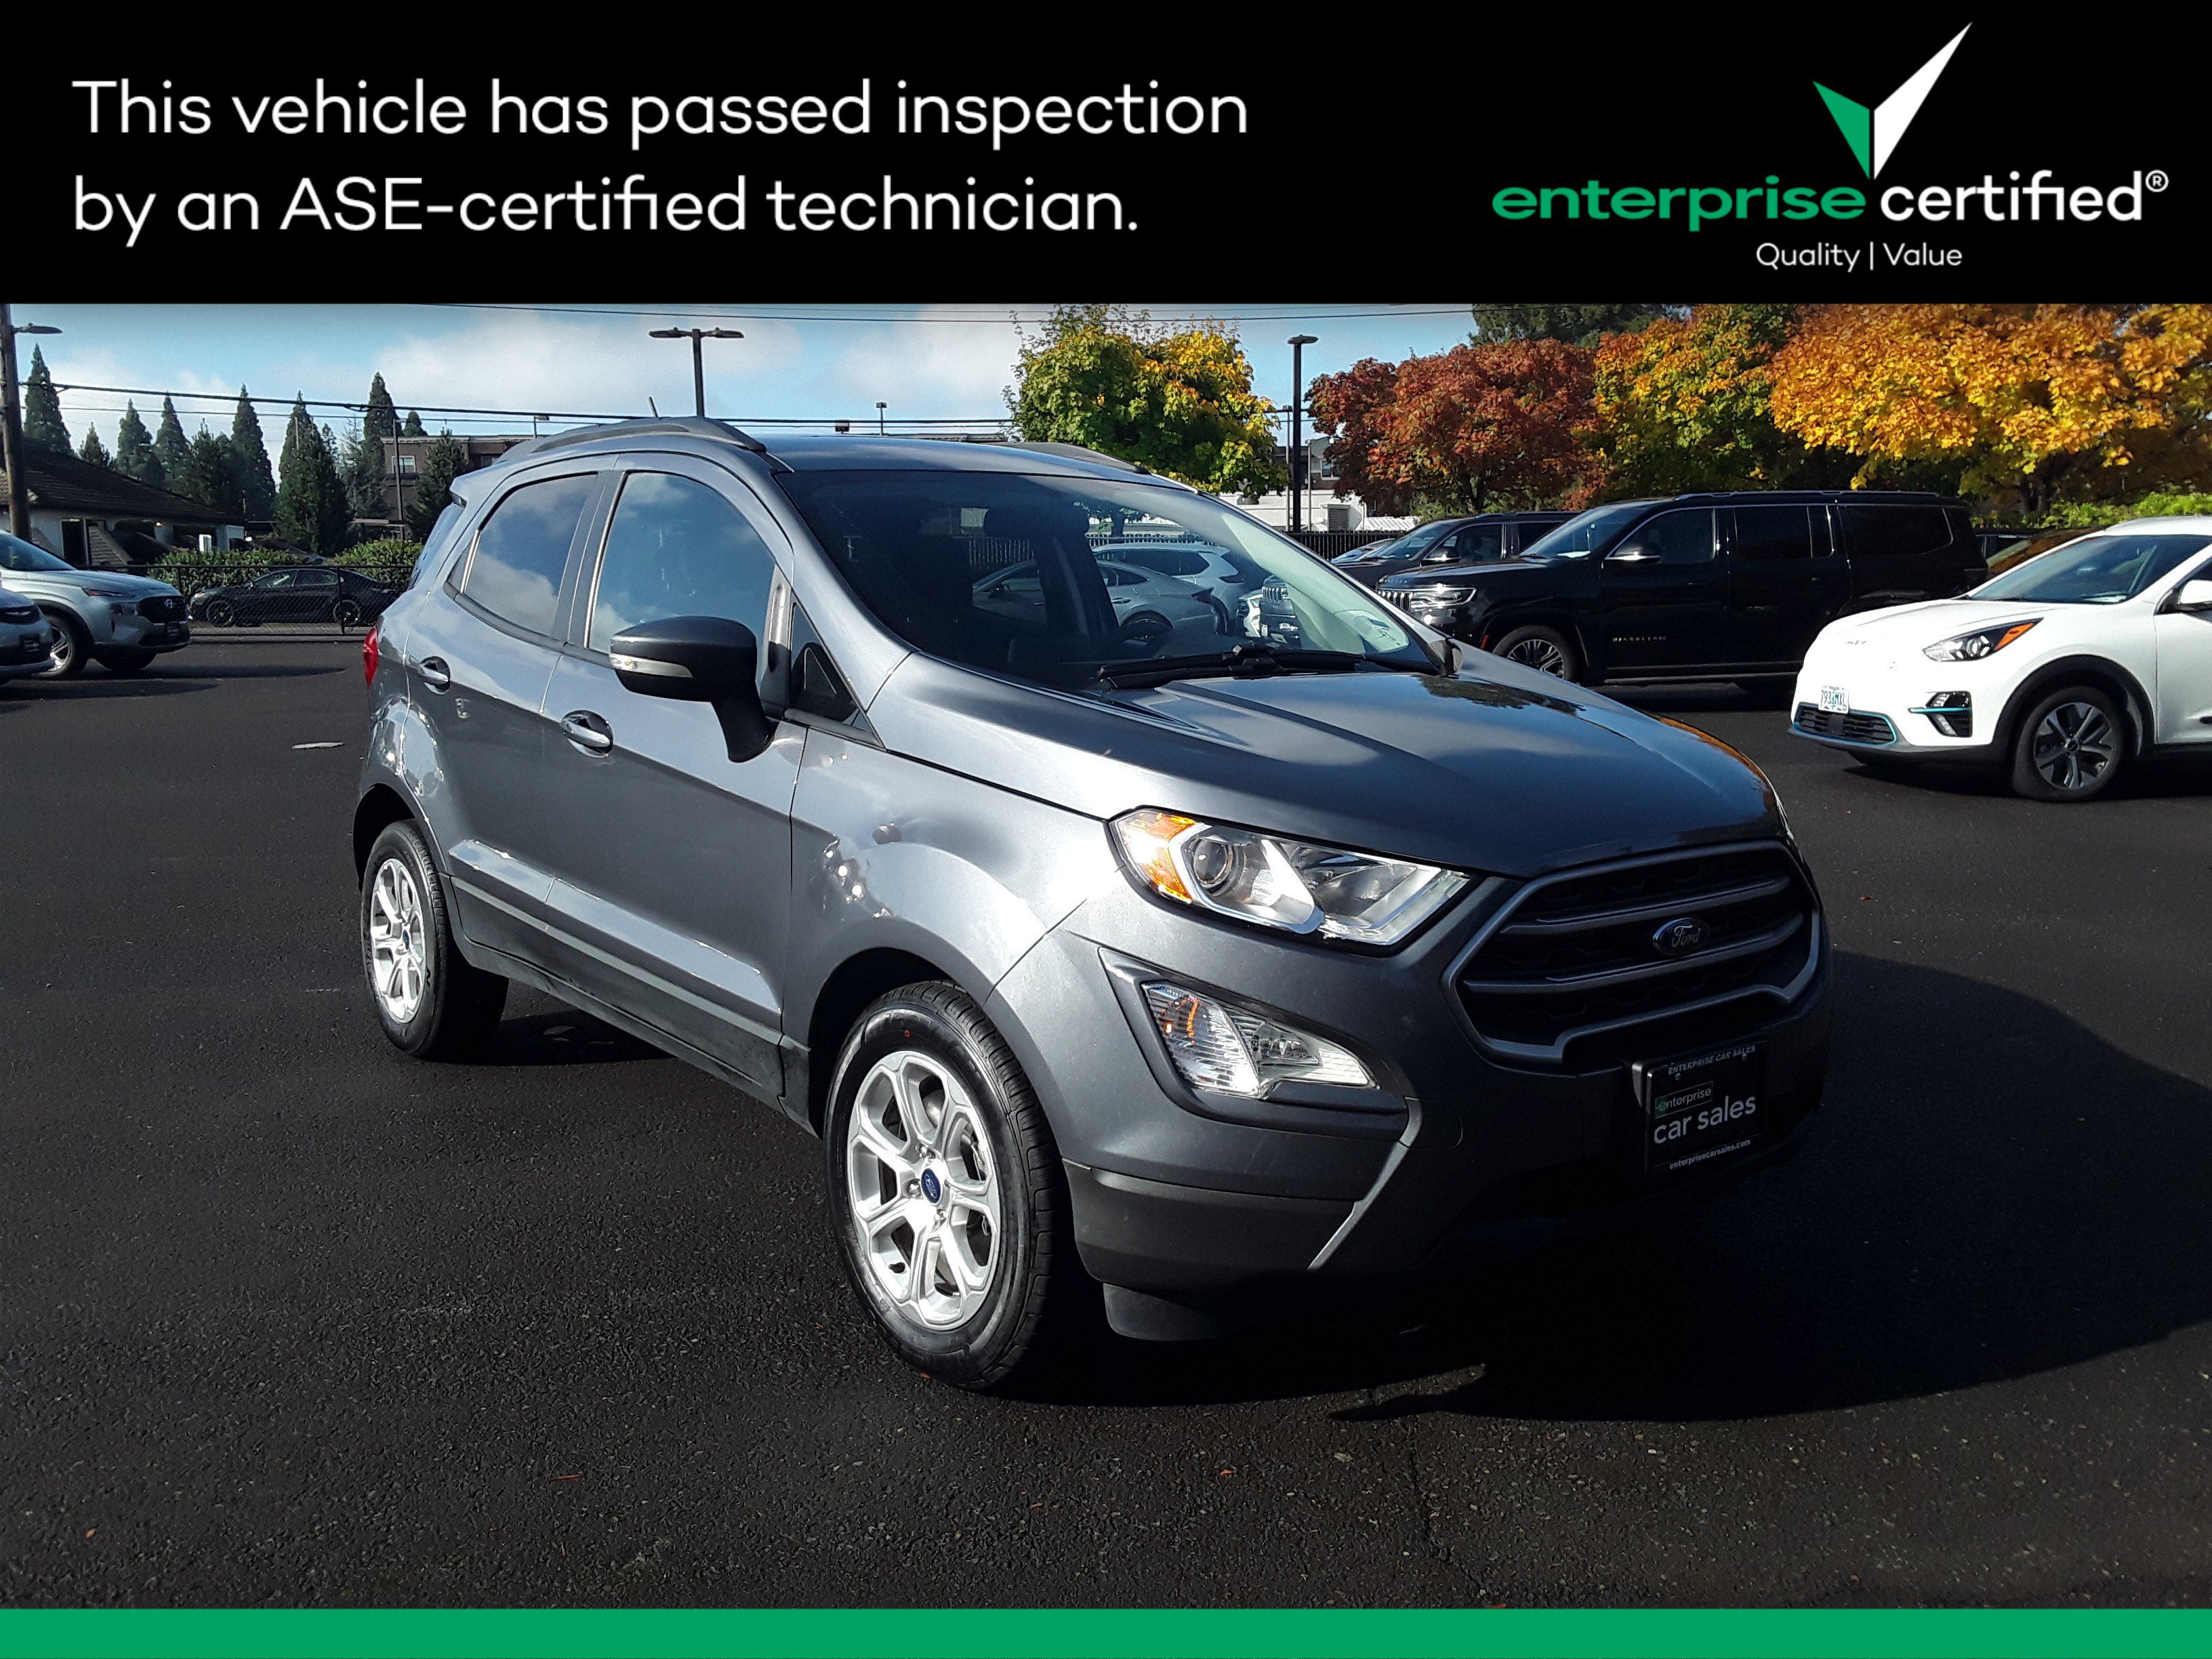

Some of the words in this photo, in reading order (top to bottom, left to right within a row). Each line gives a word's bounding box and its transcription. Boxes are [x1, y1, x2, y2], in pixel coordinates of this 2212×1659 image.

[1671, 924, 1701, 947] Ford
[1668, 1056, 1715, 1076] ENTERPRISE
[1715, 1050, 1732, 1063] CAR
[1658, 1087, 1712, 1111] enterprise
[1654, 1115, 1693, 1144] car
[1697, 1095, 1757, 1130] sales
